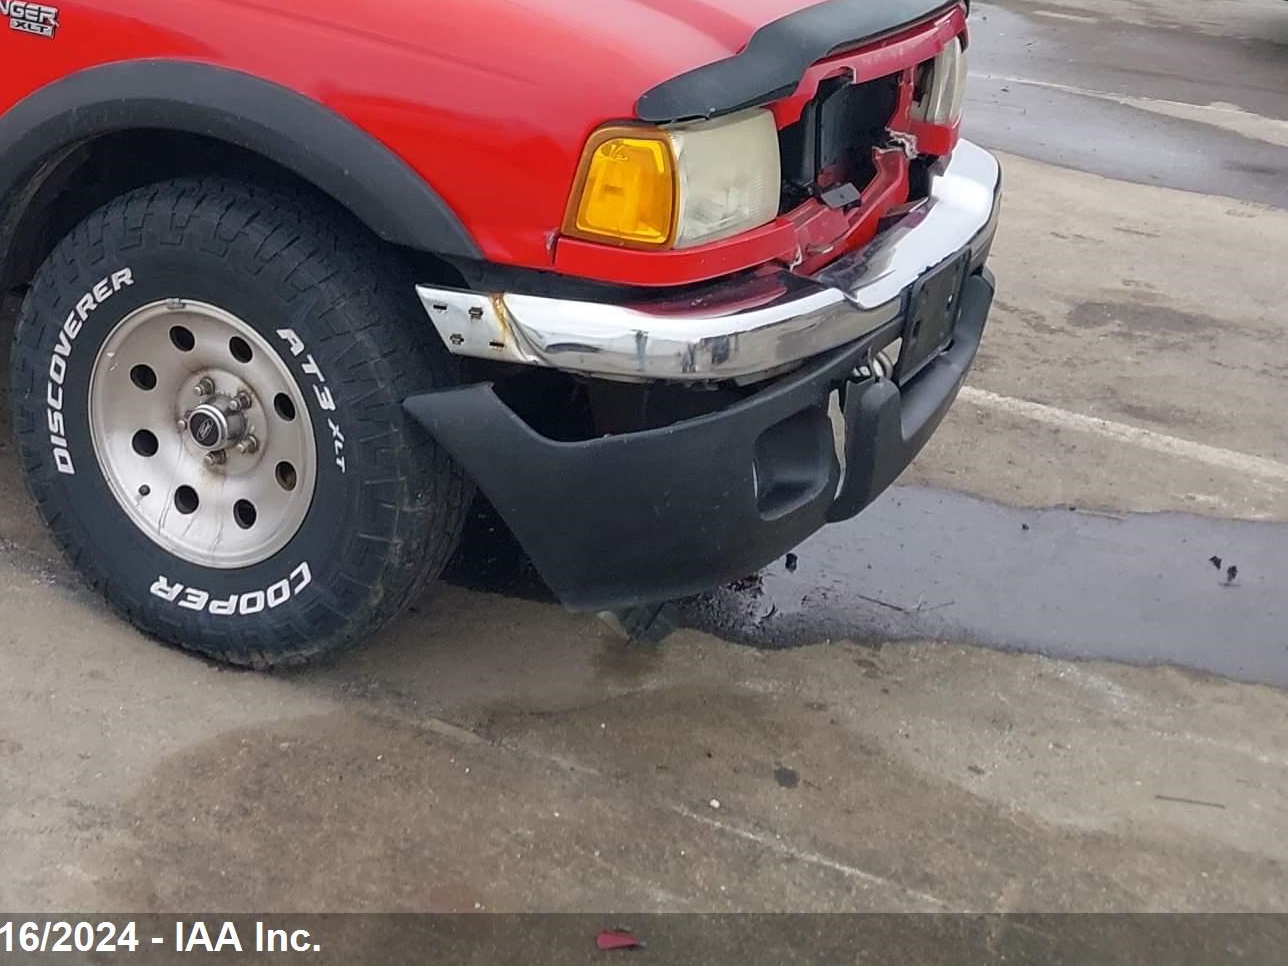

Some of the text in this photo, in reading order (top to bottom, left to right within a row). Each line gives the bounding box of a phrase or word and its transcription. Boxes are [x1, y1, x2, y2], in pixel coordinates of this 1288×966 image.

[13, 19, 50, 34] XLT
[47, 267, 135, 475] DISCOVERER
[276, 328, 346, 474] AT3 XLT
[150, 561, 312, 616] COOPER
